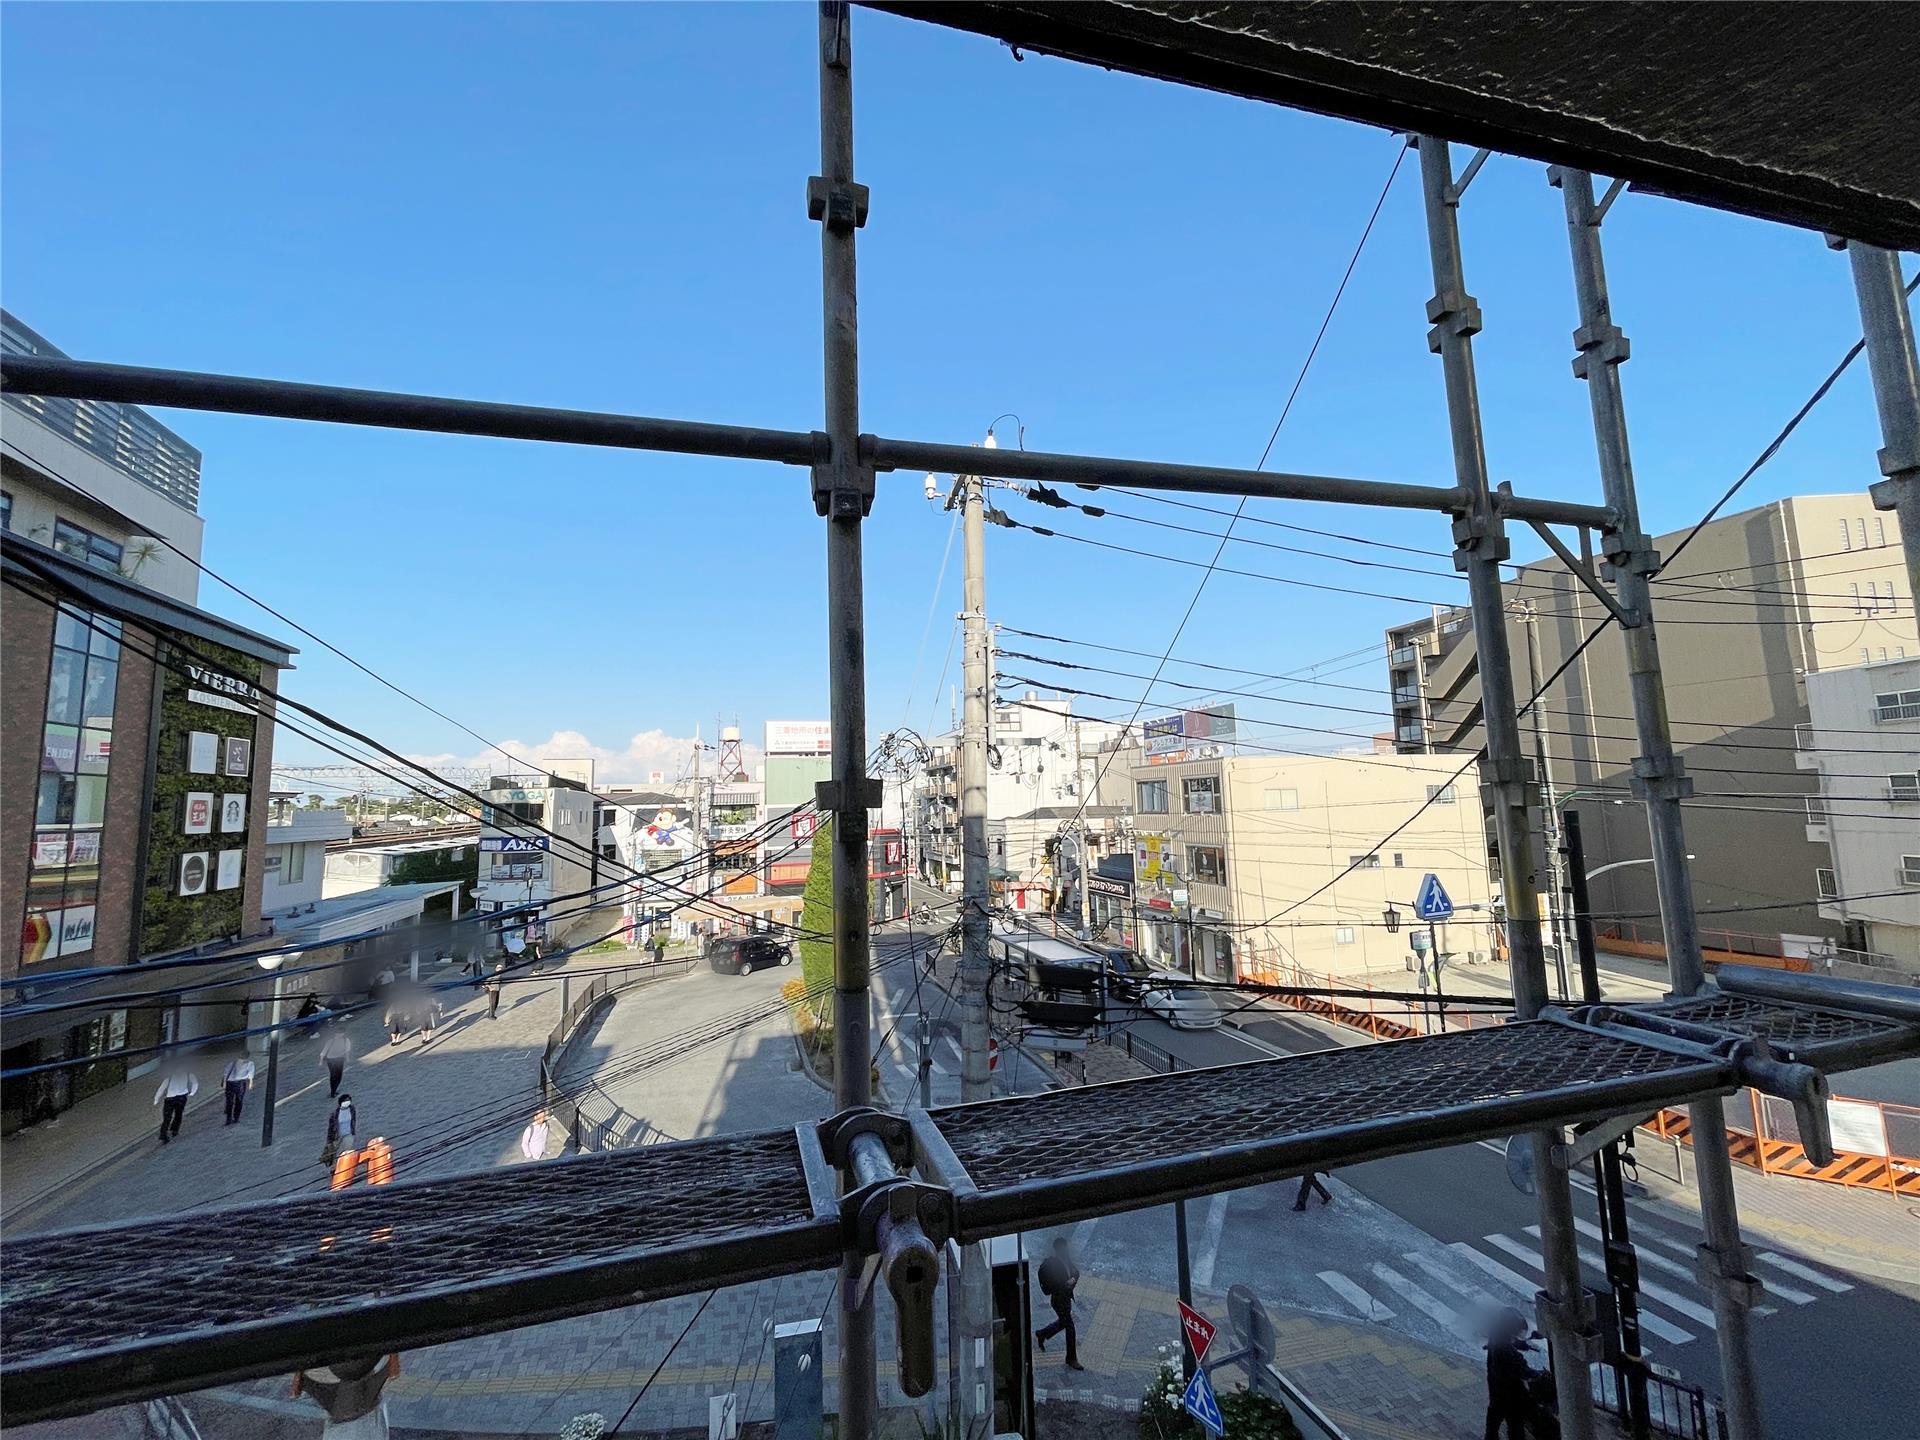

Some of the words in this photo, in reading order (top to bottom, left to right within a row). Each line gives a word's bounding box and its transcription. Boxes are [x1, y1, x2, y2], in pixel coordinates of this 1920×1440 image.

[46, 746, 74, 759] ENJOY
[511, 790, 544, 801] YOGA
[1185, 1315, 1209, 1340] 止まれ
